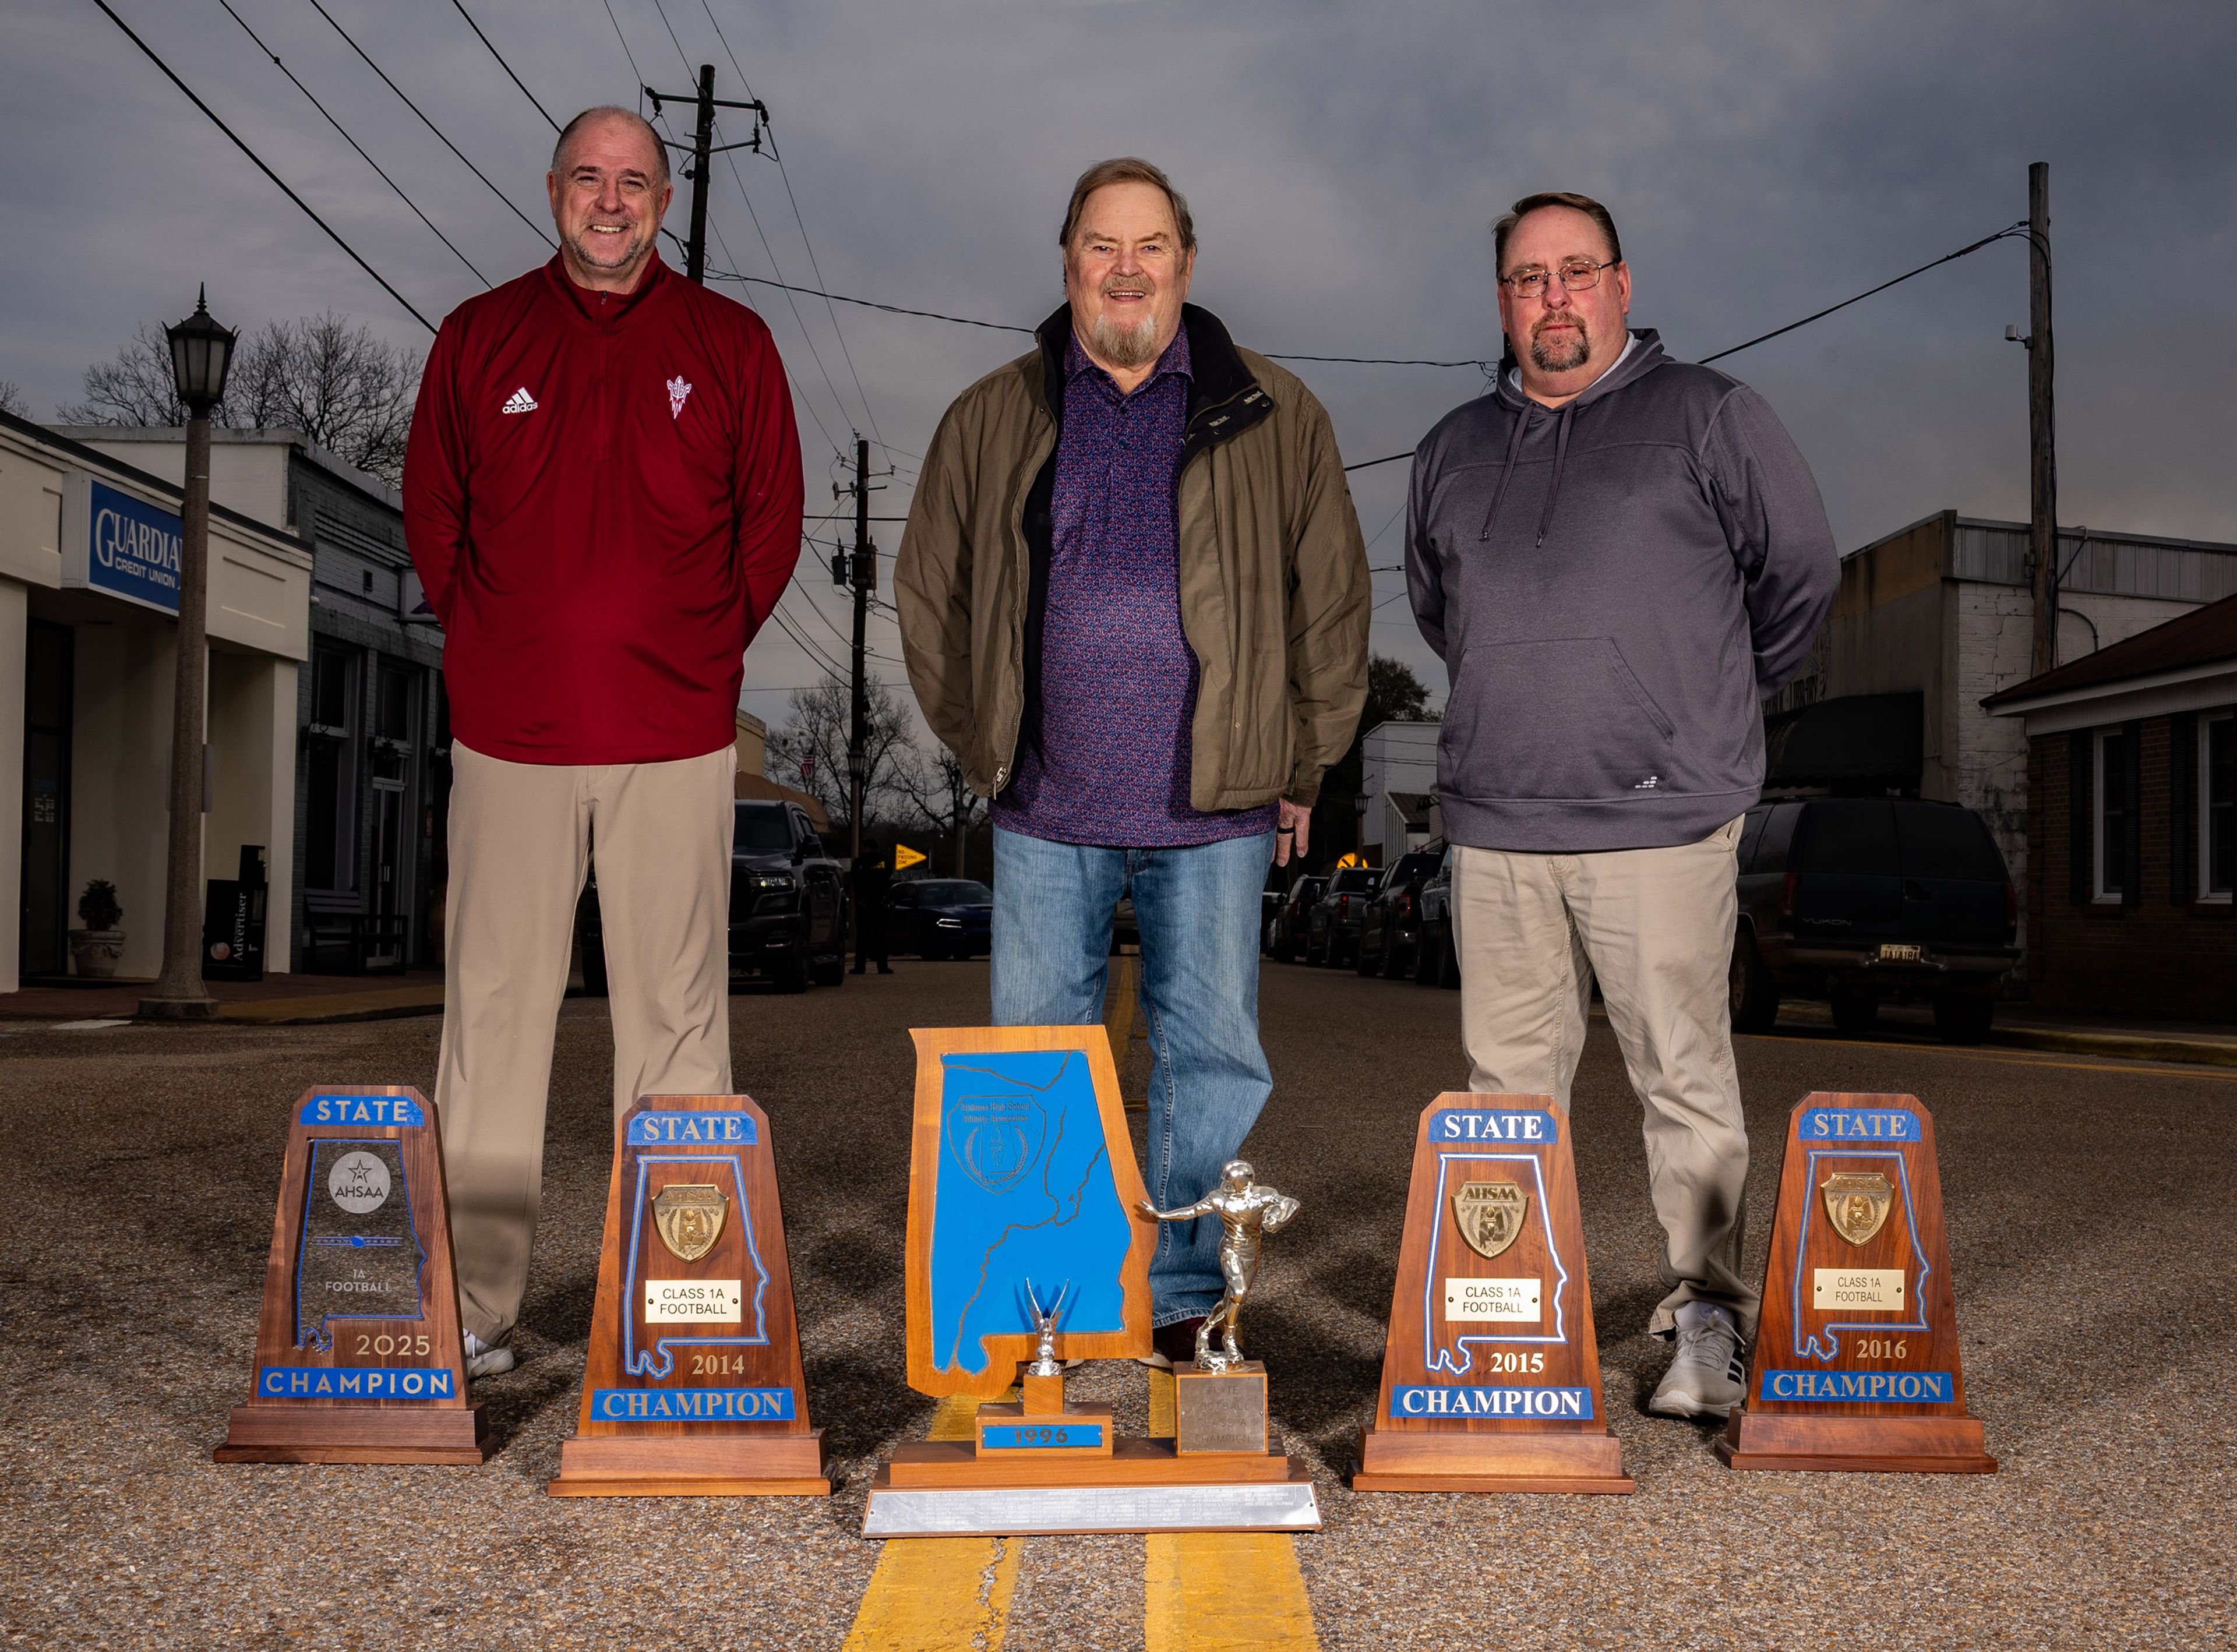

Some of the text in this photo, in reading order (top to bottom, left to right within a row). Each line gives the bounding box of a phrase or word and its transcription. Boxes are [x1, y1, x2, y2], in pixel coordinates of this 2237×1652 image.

[502, 402, 538, 414] adidas
[96, 508, 183, 573] GUARDIA
[115, 557, 175, 588] CREDIT UNION
[233, 892, 247, 961] Advertiser
[1802, 917, 1853, 927] YUKON
[316, 1100, 408, 1122] STATE
[961, 1101, 1030, 1111] Alabama High School
[964, 1113, 1029, 1122] Athletic Association
[1813, 1114, 1907, 1136] STATE
[643, 1117, 742, 1141] STATE
[1444, 1115, 1543, 1139] STATE
[1833, 1177, 1885, 1191] AHSAA
[335, 1186, 383, 1198] AHSAA
[662, 1189, 718, 1205] AHSAA
[1463, 1185, 1518, 1201] AHSAA
[352, 1269, 365, 1279] 1A
[326, 1282, 392, 1292] FOOTBALL
[1837, 1277, 1881, 1288] CLASS 1A
[662, 1288, 724, 1300] CLASS 1A
[1465, 1287, 1520, 1298] CLASS 1A
[1835, 1291, 1882, 1302] FOOTBALL
[659, 1304, 727, 1315] FOOTBALL
[1463, 1302, 1523, 1313] FOOTBALL
[356, 1335, 431, 1356] 2025
[1857, 1339, 1907, 1359] 2016
[691, 1355, 745, 1375] 2014
[1490, 1352, 1544, 1372] 2015
[265, 1372, 449, 1394] CHAMPION
[1205, 1385, 1239, 1395] STATE
[1773, 1374, 1942, 1398] CHAMPION
[604, 1392, 782, 1417] CHAMPION
[1193, 1402, 1250, 1411] OOTBALL
[1402, 1389, 1582, 1415] CHAMPION
[1197, 1418, 1234, 1427] CLASS
[1013, 1428, 1069, 1445] 1996
[1195, 1434, 1250, 1443] CHAMPION
